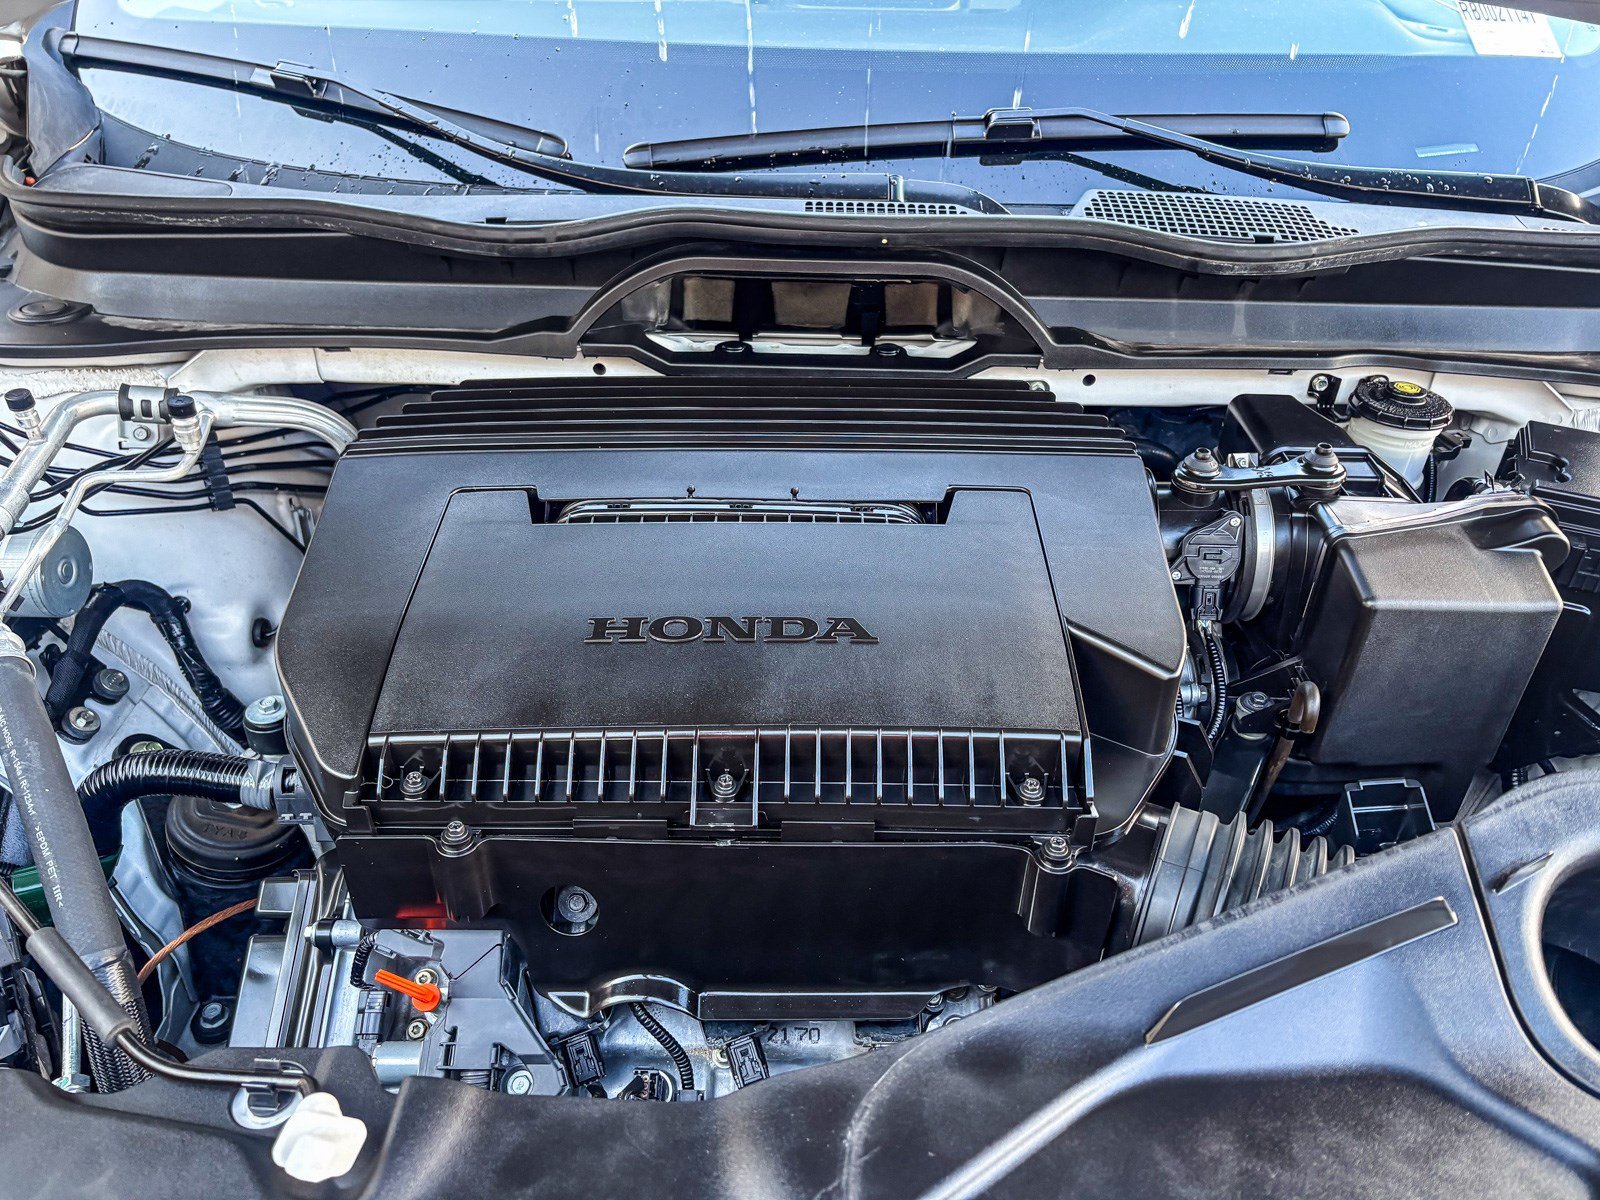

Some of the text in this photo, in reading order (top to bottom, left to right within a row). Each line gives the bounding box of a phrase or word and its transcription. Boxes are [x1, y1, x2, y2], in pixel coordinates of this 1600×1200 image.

[584, 616, 880, 643] HONDA
[2, 726, 14, 749] HOSE
[45, 861, 58, 880] PET
